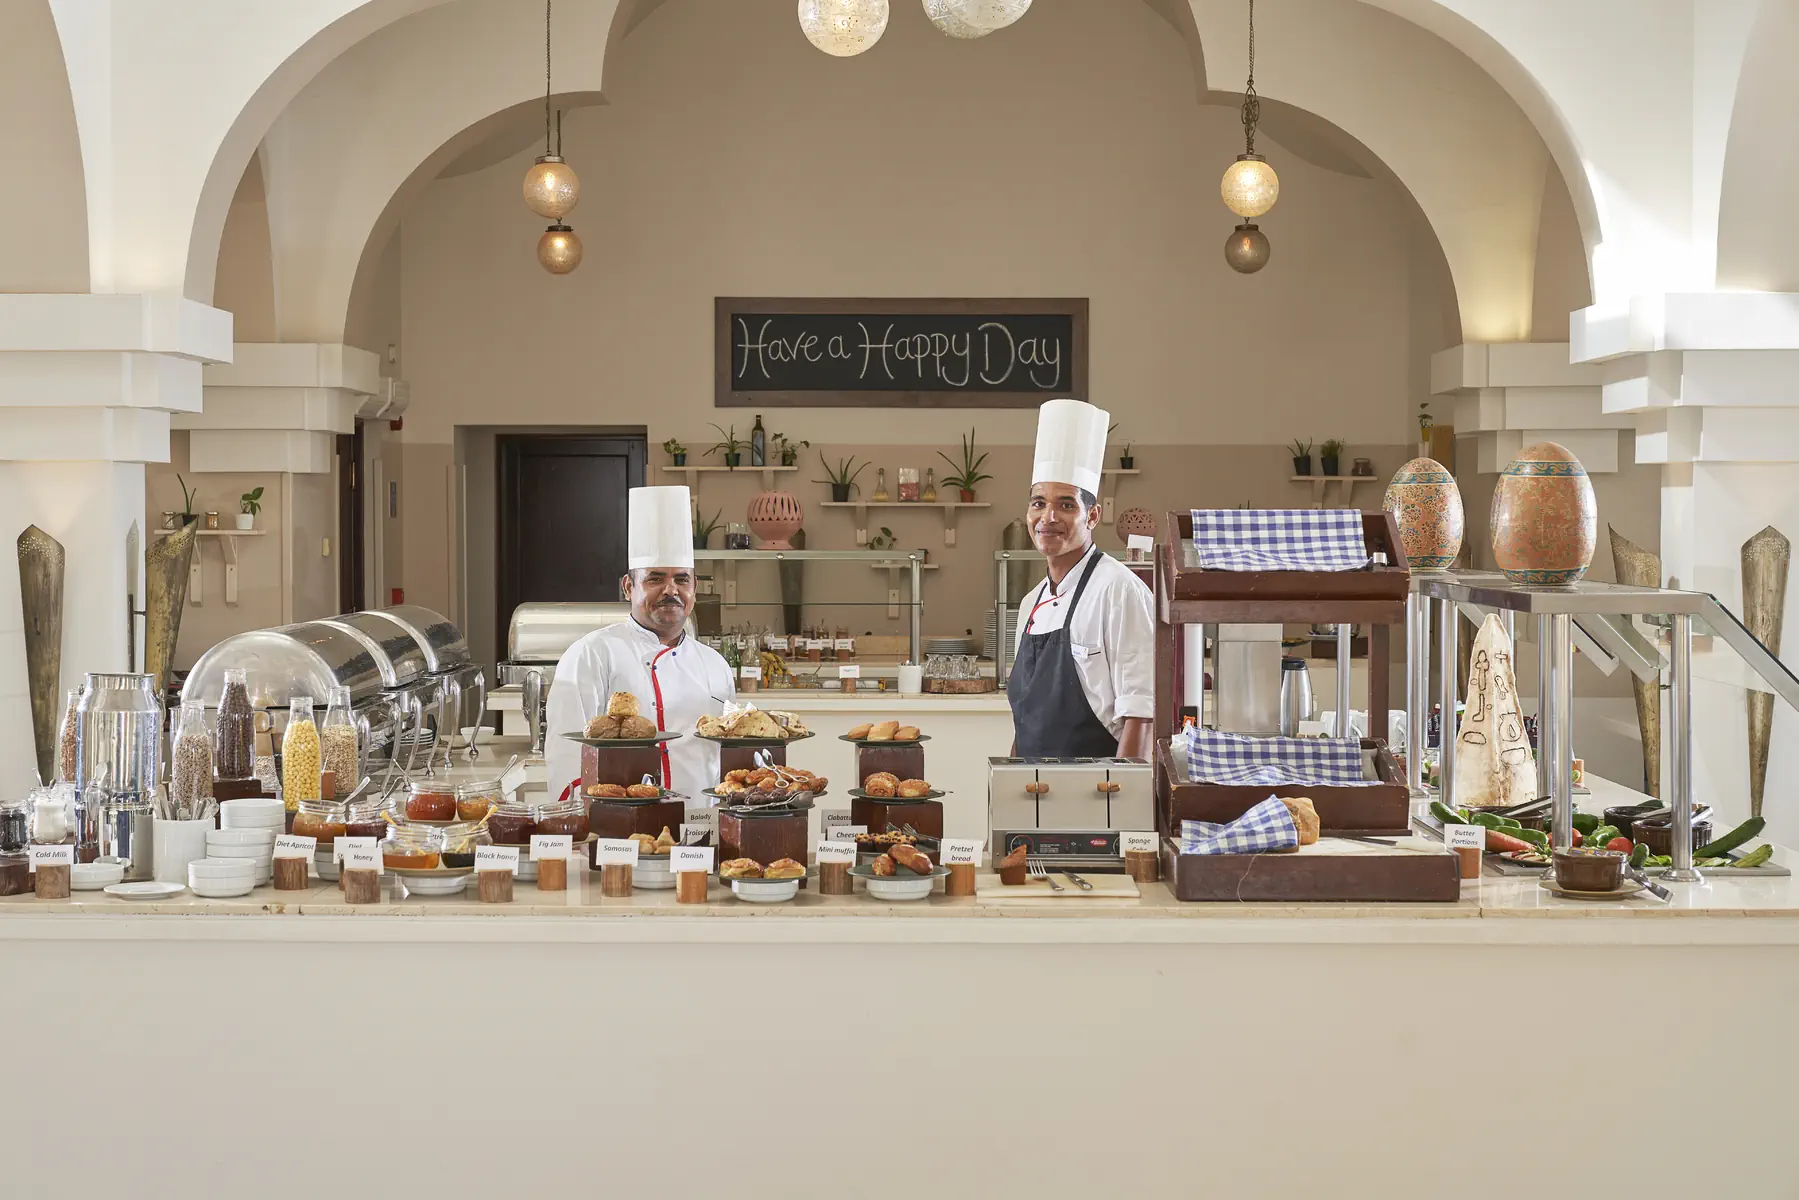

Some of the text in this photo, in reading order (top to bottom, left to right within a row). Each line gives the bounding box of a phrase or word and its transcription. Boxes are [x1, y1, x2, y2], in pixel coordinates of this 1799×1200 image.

[737, 318, 1060, 389] Have a Happy Day
[690, 813, 712, 821] Balady
[836, 831, 857, 839] Chees
[1454, 829, 1476, 837] Butter
[276, 840, 315, 850] Diet Apricot
[538, 840, 549, 849] Fig
[1127, 837, 1152, 845] Sponge
[1451, 838, 1478, 846] Portions
[603, 844, 633, 852] Samosas
[833, 847, 855, 855] muffin
[950, 845, 974, 853] Pretzel
[35, 850, 51, 858] Cold
[353, 854, 374, 862] Honey
[476, 851, 518, 861] Black honey
